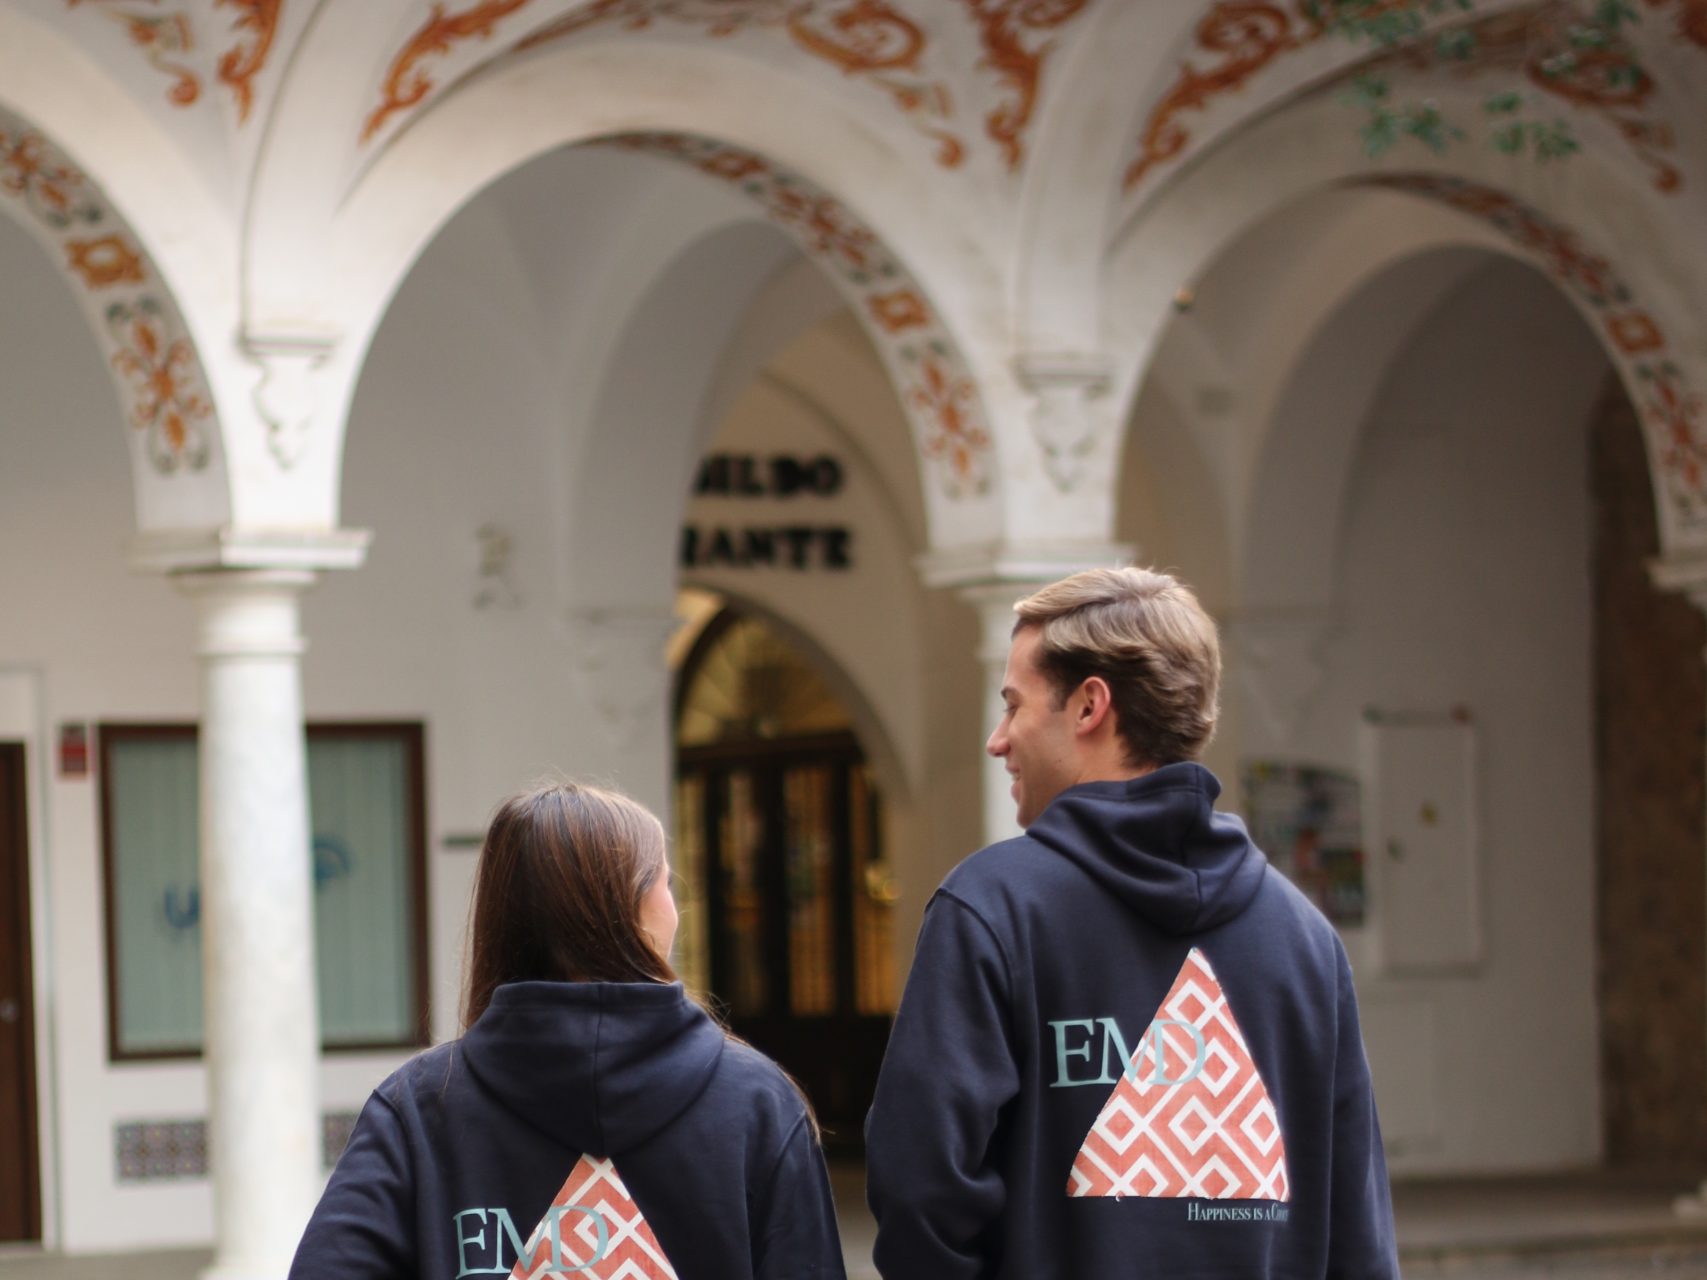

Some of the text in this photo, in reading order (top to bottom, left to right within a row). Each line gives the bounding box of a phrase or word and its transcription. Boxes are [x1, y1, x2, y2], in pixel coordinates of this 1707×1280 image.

[1047, 1016, 1206, 1088] EMD
[452, 1204, 609, 1280] EMD
[1187, 1202, 1251, 1221] HAPPINESS
[1253, 1207, 1263, 1221] IS
